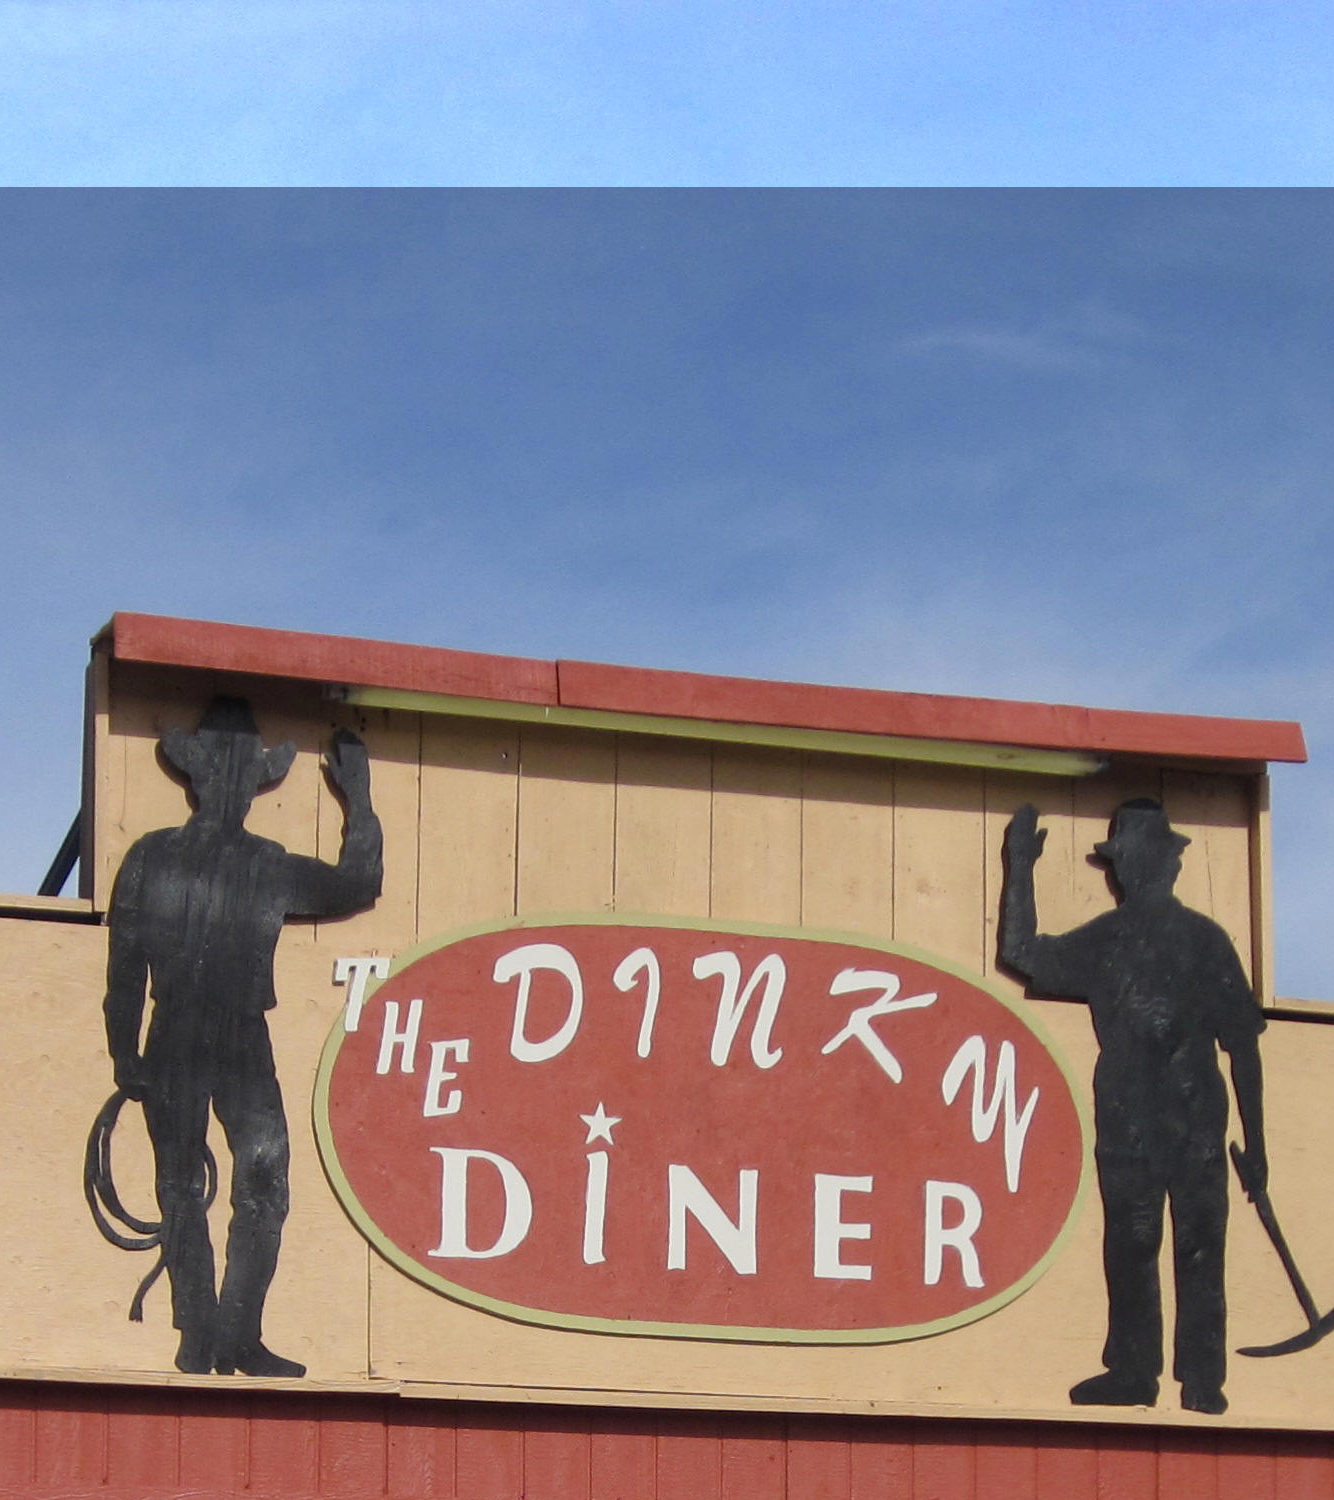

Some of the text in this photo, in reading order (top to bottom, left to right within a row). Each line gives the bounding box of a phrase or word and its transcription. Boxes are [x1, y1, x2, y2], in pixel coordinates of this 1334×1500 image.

[332, 942, 1040, 1193] THE DINKY
[427, 1103, 985, 1289] DINER
